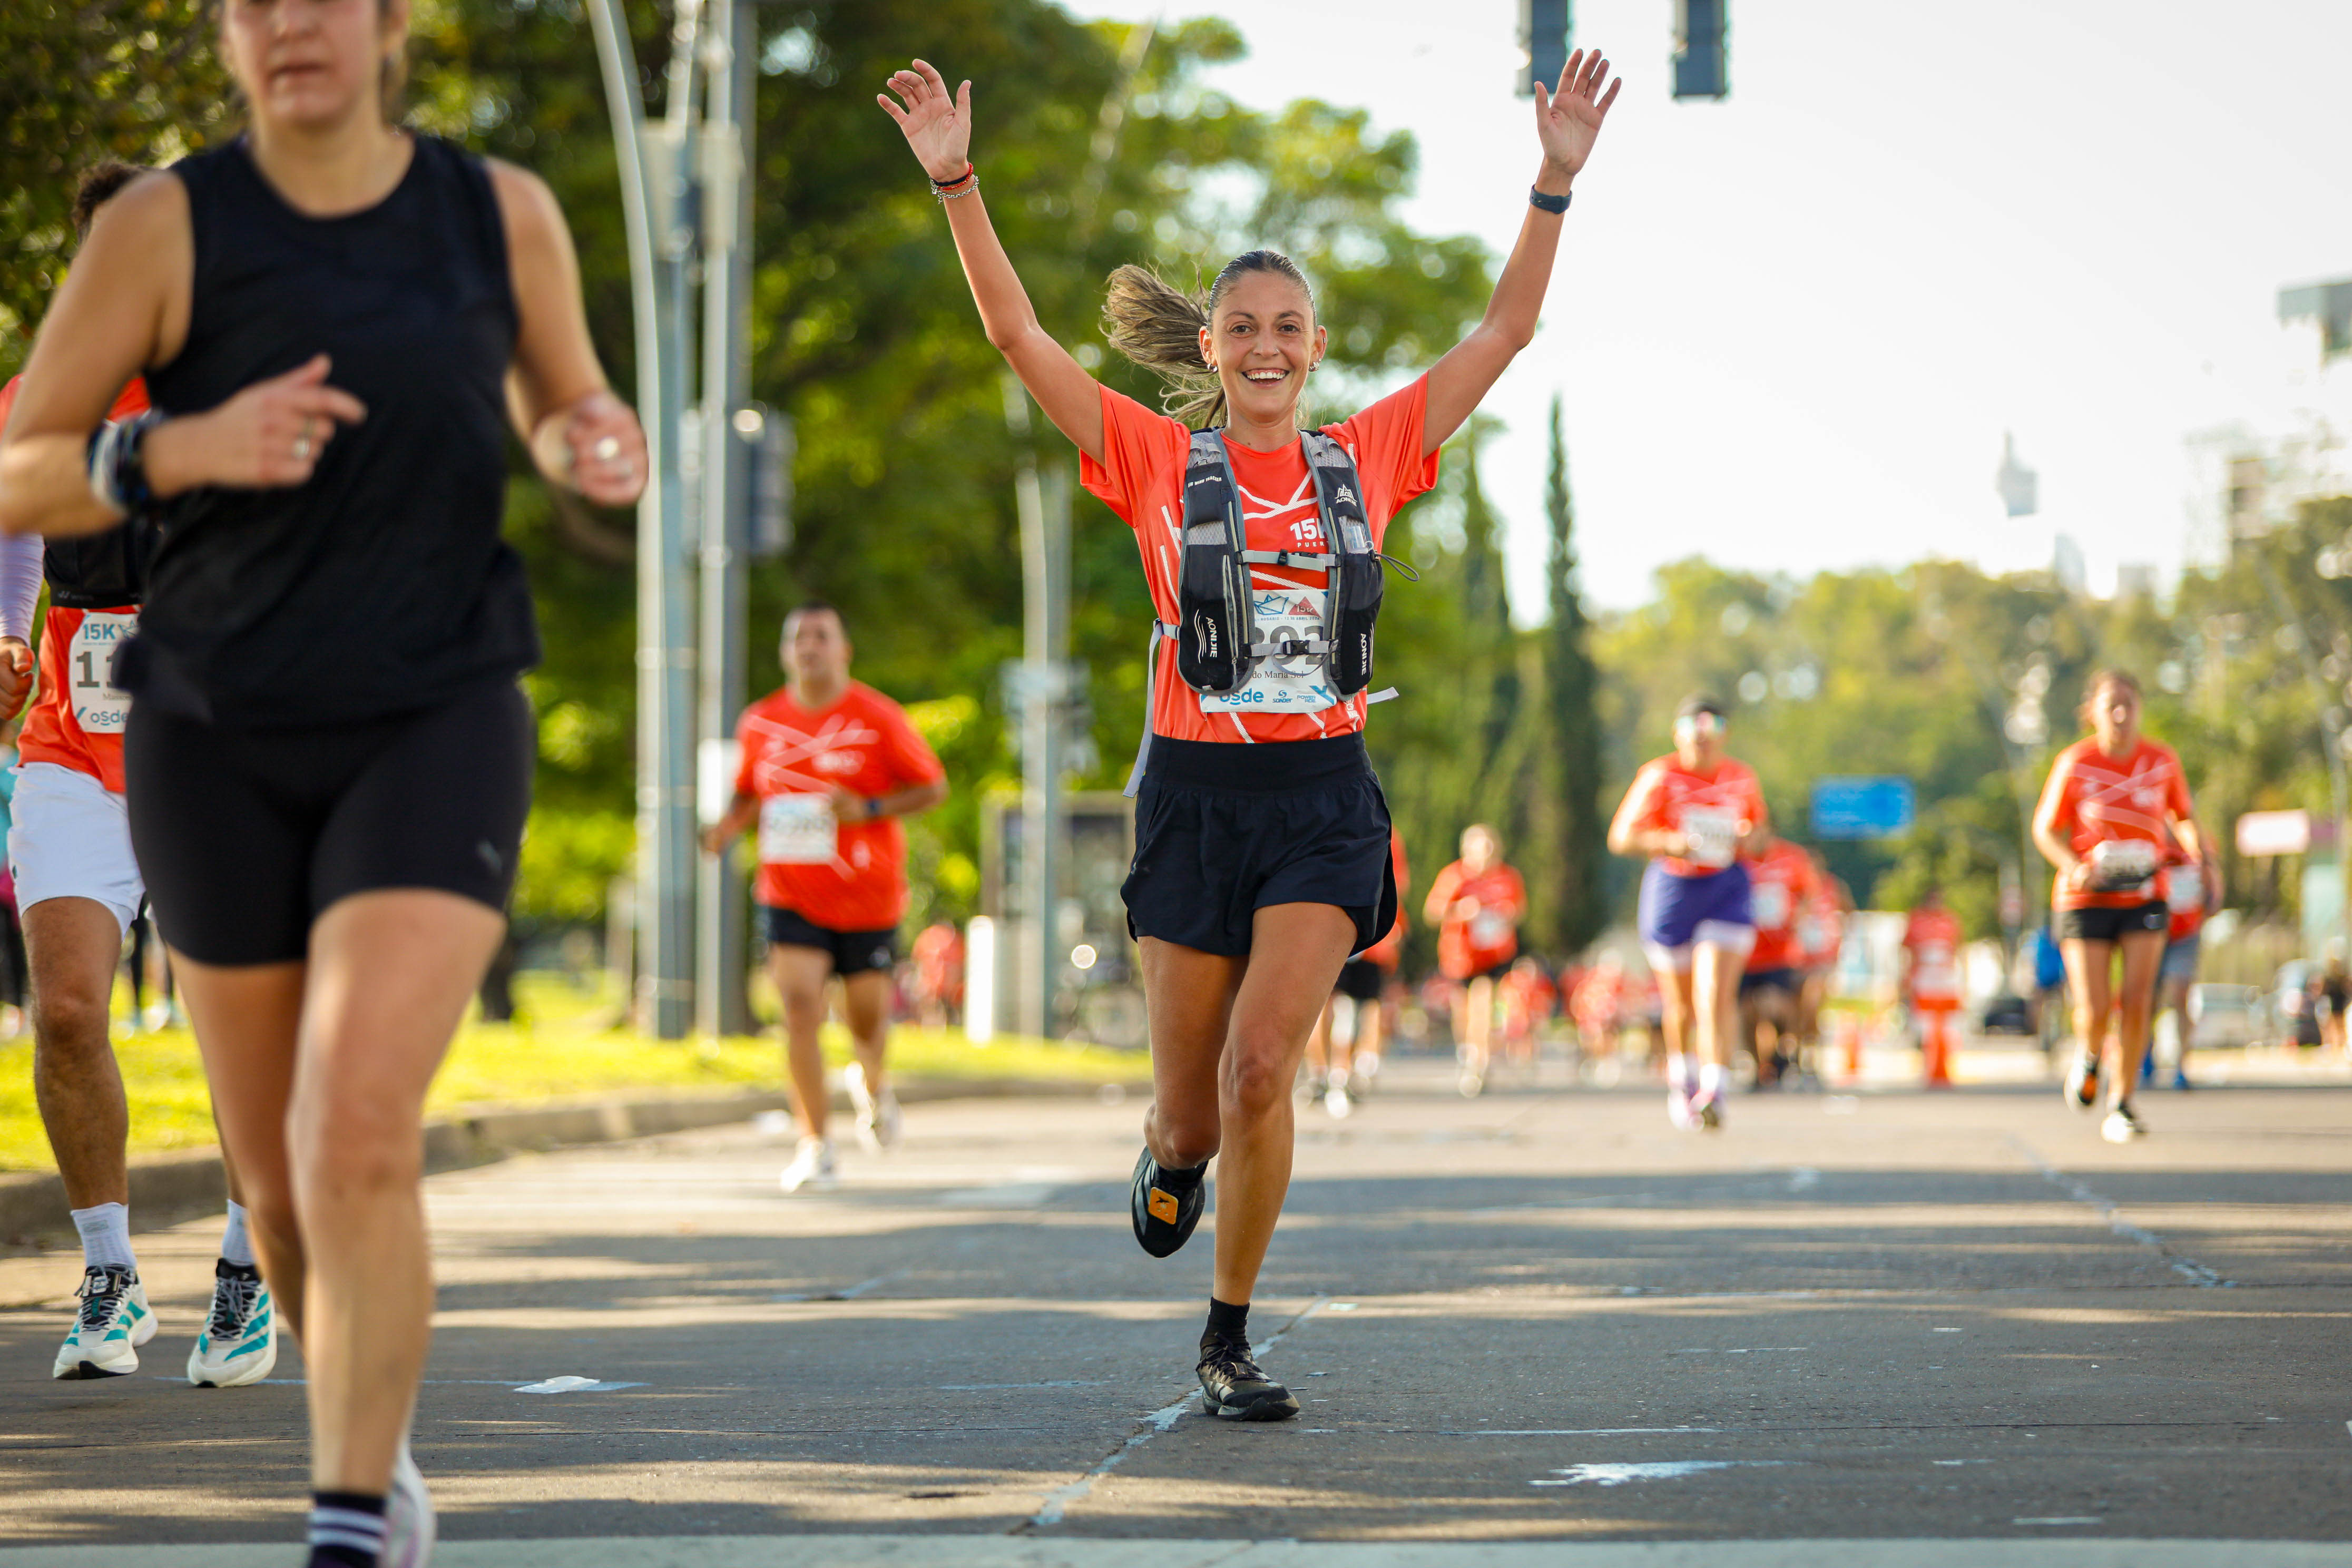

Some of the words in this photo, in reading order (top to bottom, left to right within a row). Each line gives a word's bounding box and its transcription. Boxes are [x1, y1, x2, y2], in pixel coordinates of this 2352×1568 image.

[83, 624, 115, 640] 15K
[1206, 616, 1218, 658] AONIJE
[91, 710, 128, 726] osde
